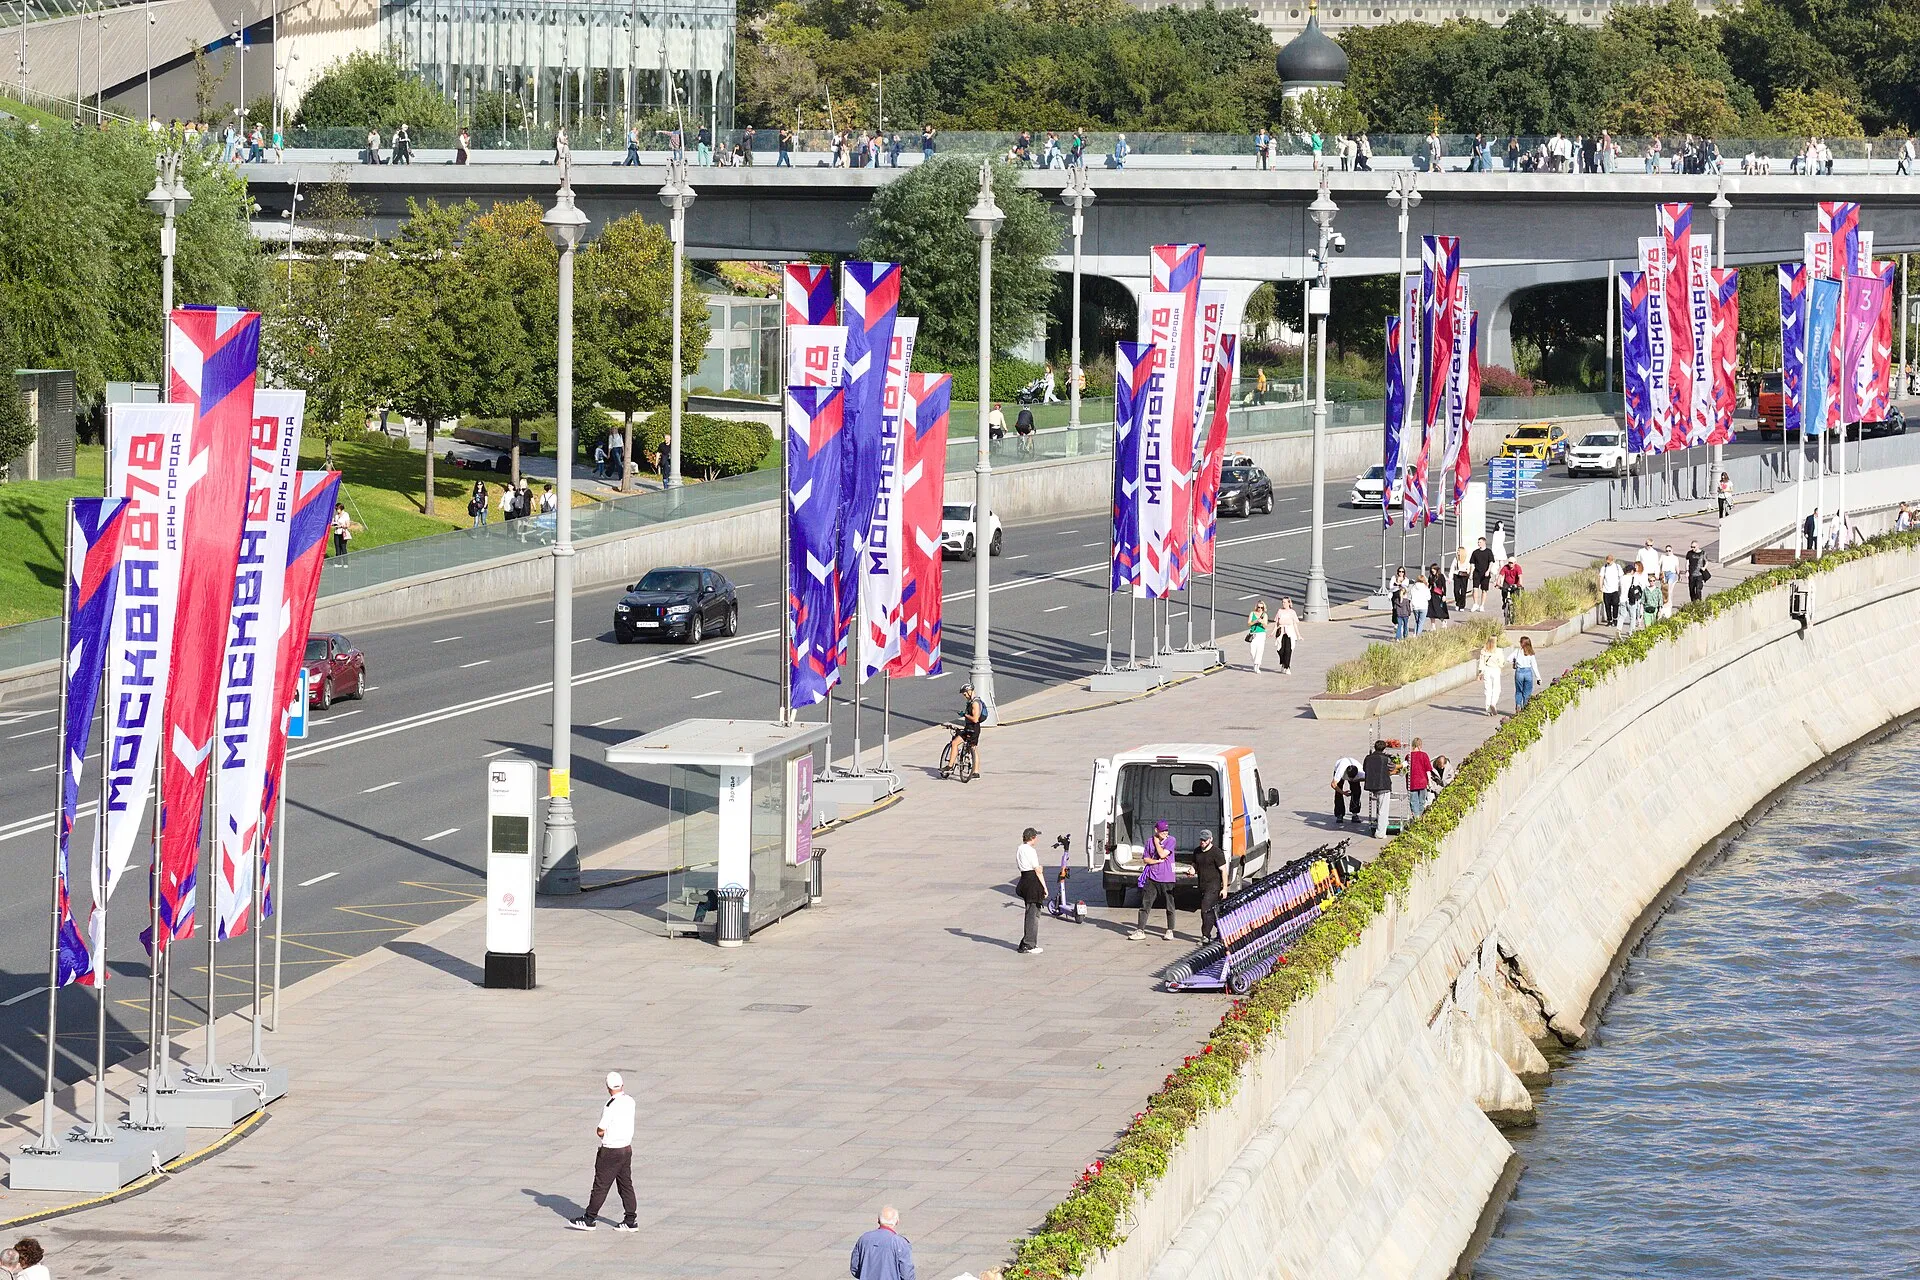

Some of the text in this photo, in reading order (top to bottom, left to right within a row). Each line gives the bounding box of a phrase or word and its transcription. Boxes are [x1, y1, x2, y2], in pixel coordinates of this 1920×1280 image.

[1648, 247, 1660, 292] 878
[1691, 245, 1707, 382] МОСКВА 878
[1815, 293, 1825, 315] 4
[1860, 289, 1872, 311] 3
[804, 345, 830, 387] 78
[830, 345, 840, 386] ОРОДА
[1171, 308, 1180, 343] ГОРОДА
[1203, 304, 1218, 363] 878
[1650, 294, 1665, 389] МОСКВА
[1144, 307, 1171, 505] МОСКВА 878
[1451, 338, 1462, 445] ОСКВА
[166, 433, 182, 550] ДЕНЬ ГОРОДА
[276, 416, 295, 523] ДЕНЬ ГОРОДА
[108, 433, 166, 811] МОСКВА 878
[222, 530, 267, 770] МОСКВА
